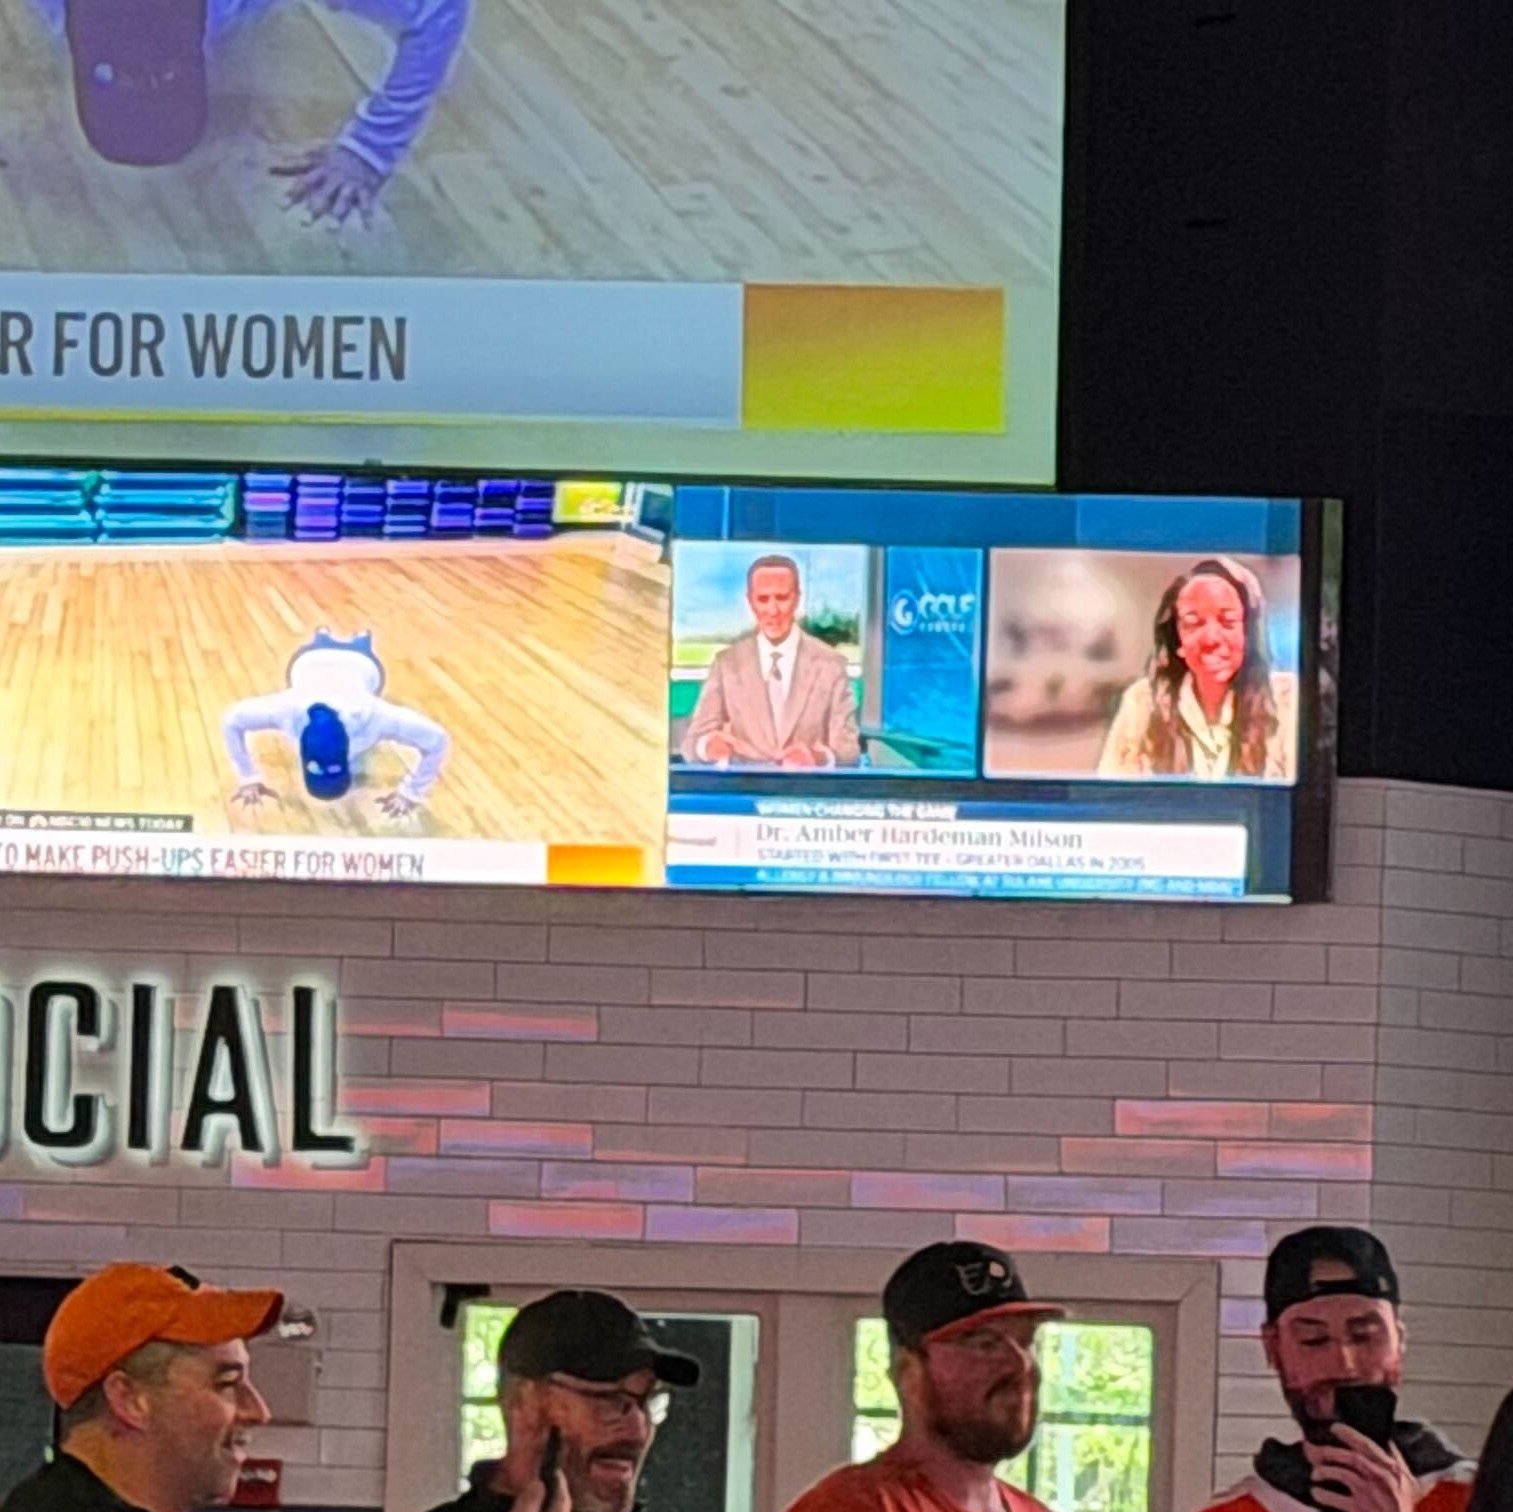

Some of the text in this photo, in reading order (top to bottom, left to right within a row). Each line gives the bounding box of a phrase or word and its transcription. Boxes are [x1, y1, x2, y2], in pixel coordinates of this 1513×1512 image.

[53, 312, 164, 377] FOR
[184, 314, 406, 380] WOMEN
[756, 822, 791, 843] Dr.
[796, 824, 874, 845] Amber
[25, 844, 84, 872] MAKE
[92, 846, 204, 874] PUSH-UPS
[210, 848, 286, 877] EASIER
[294, 850, 335, 877] FOR
[341, 851, 425, 880] WOMEN
